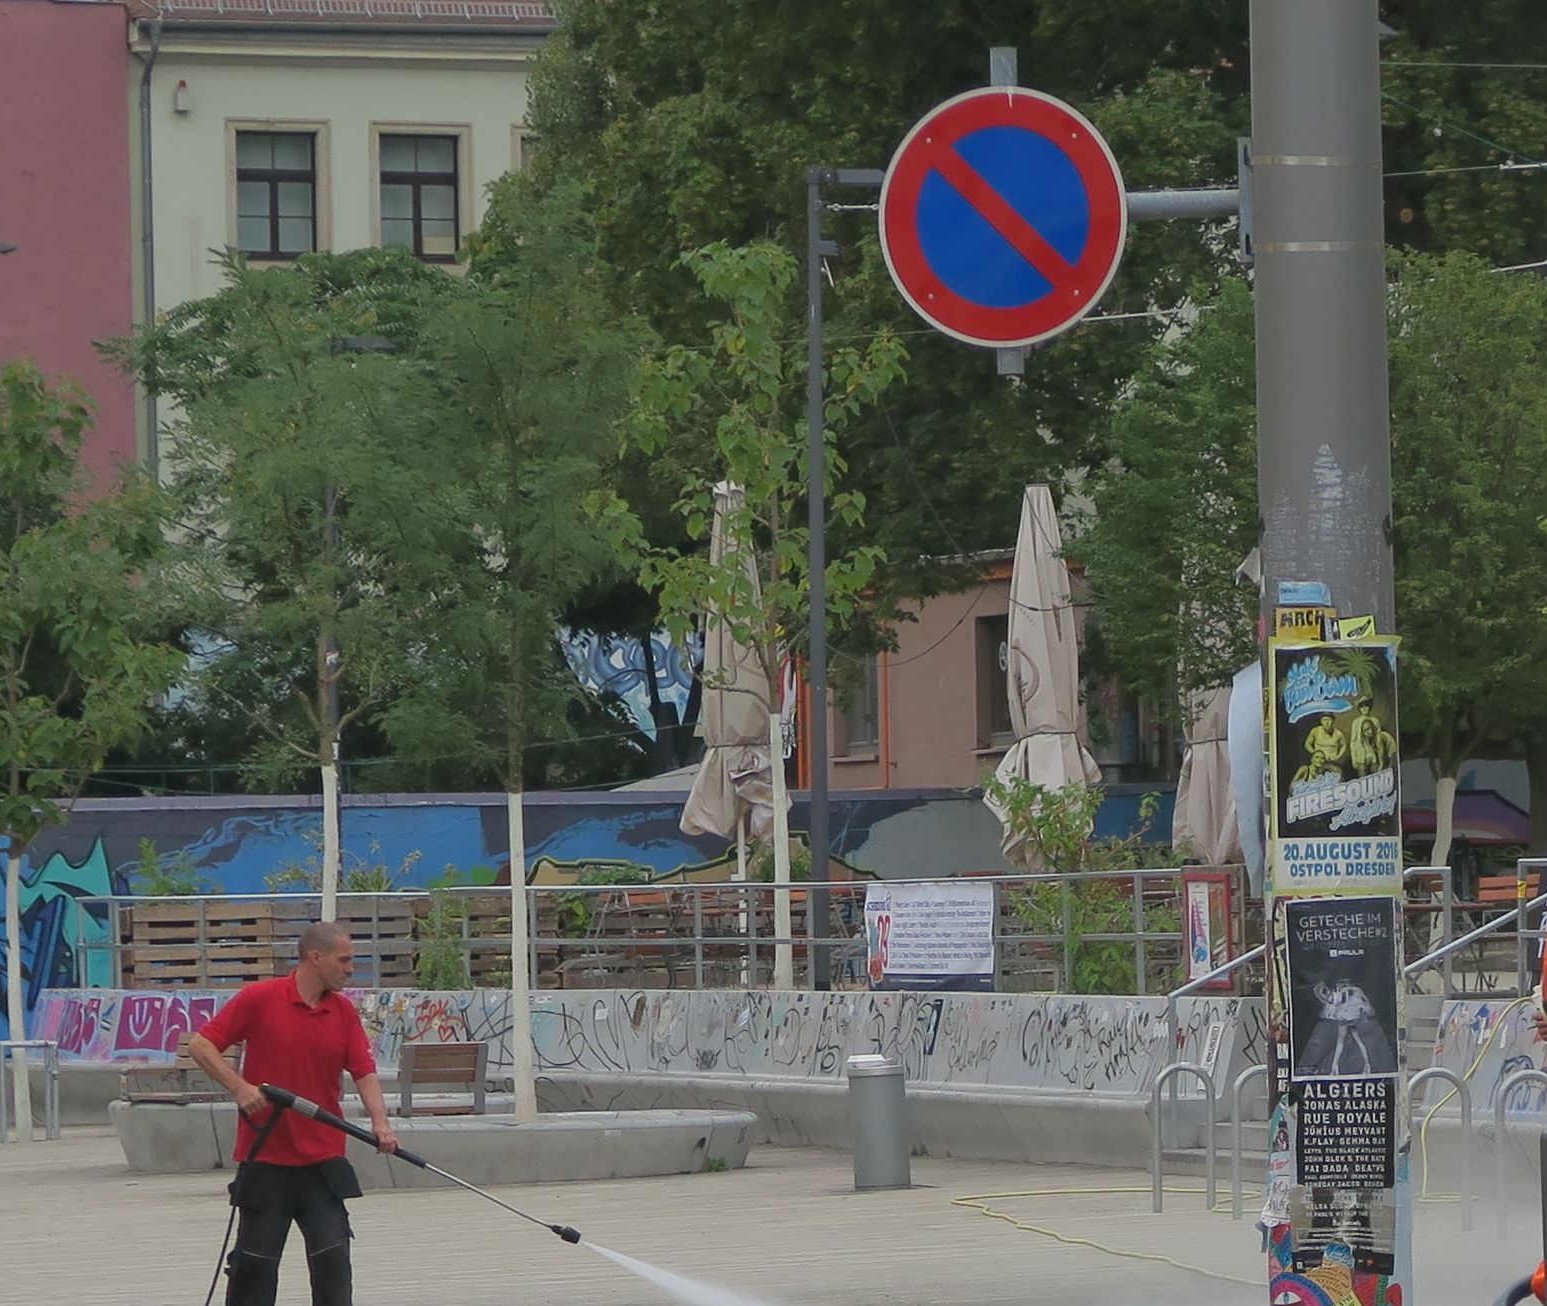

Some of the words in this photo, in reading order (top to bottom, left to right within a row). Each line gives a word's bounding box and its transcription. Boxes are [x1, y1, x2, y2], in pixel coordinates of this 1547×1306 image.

[1286, 767, 1394, 823] FIRESOUND
[1284, 841, 1372, 861] 20.AUGUST
[1290, 863, 1342, 877] OSTPOL
[1345, 862, 1396, 876] DRESDEN
[1299, 914, 1365, 929] GETECHE
[1367, 912, 1382, 924] IM
[1296, 926, 1388, 943] VERSTECHE#2
[1337, 948, 1365, 956] PAULA
[1303, 1081, 1386, 1099] ALGIERS
[1303, 1100, 1341, 1111] JONAS
[1344, 1100, 1387, 1110] ALASKA
[1303, 1113, 1331, 1124] RUE
[1337, 1112, 1386, 1124] ROYALE
[1303, 1137, 1334, 1146] K.FLAY
[1339, 1137, 1371, 1146] GEMMA
